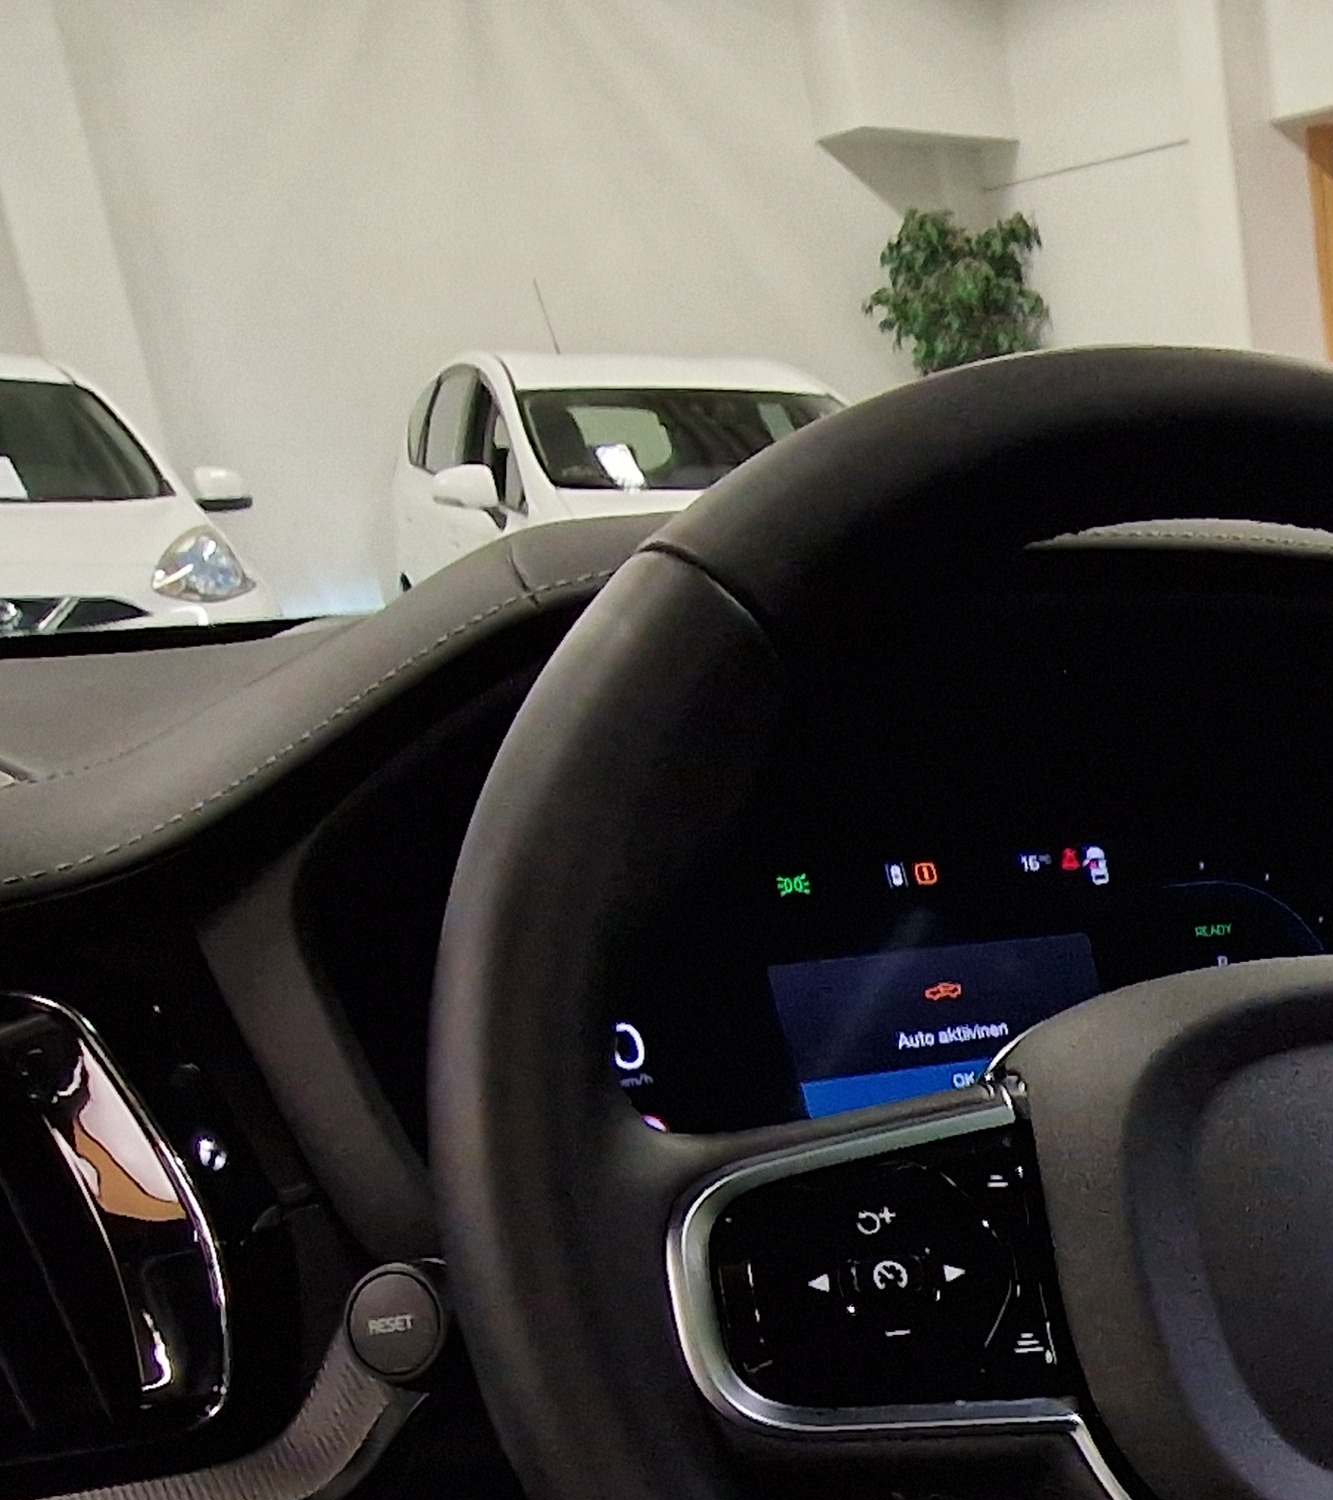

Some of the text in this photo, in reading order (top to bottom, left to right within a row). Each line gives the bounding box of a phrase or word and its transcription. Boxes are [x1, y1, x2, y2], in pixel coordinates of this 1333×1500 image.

[1194, 922, 1232, 937] READY
[898, 1022, 1009, 1050] Auto aktiivinen
[953, 1071, 975, 1089] OK
[367, 1314, 413, 1336] RESET
